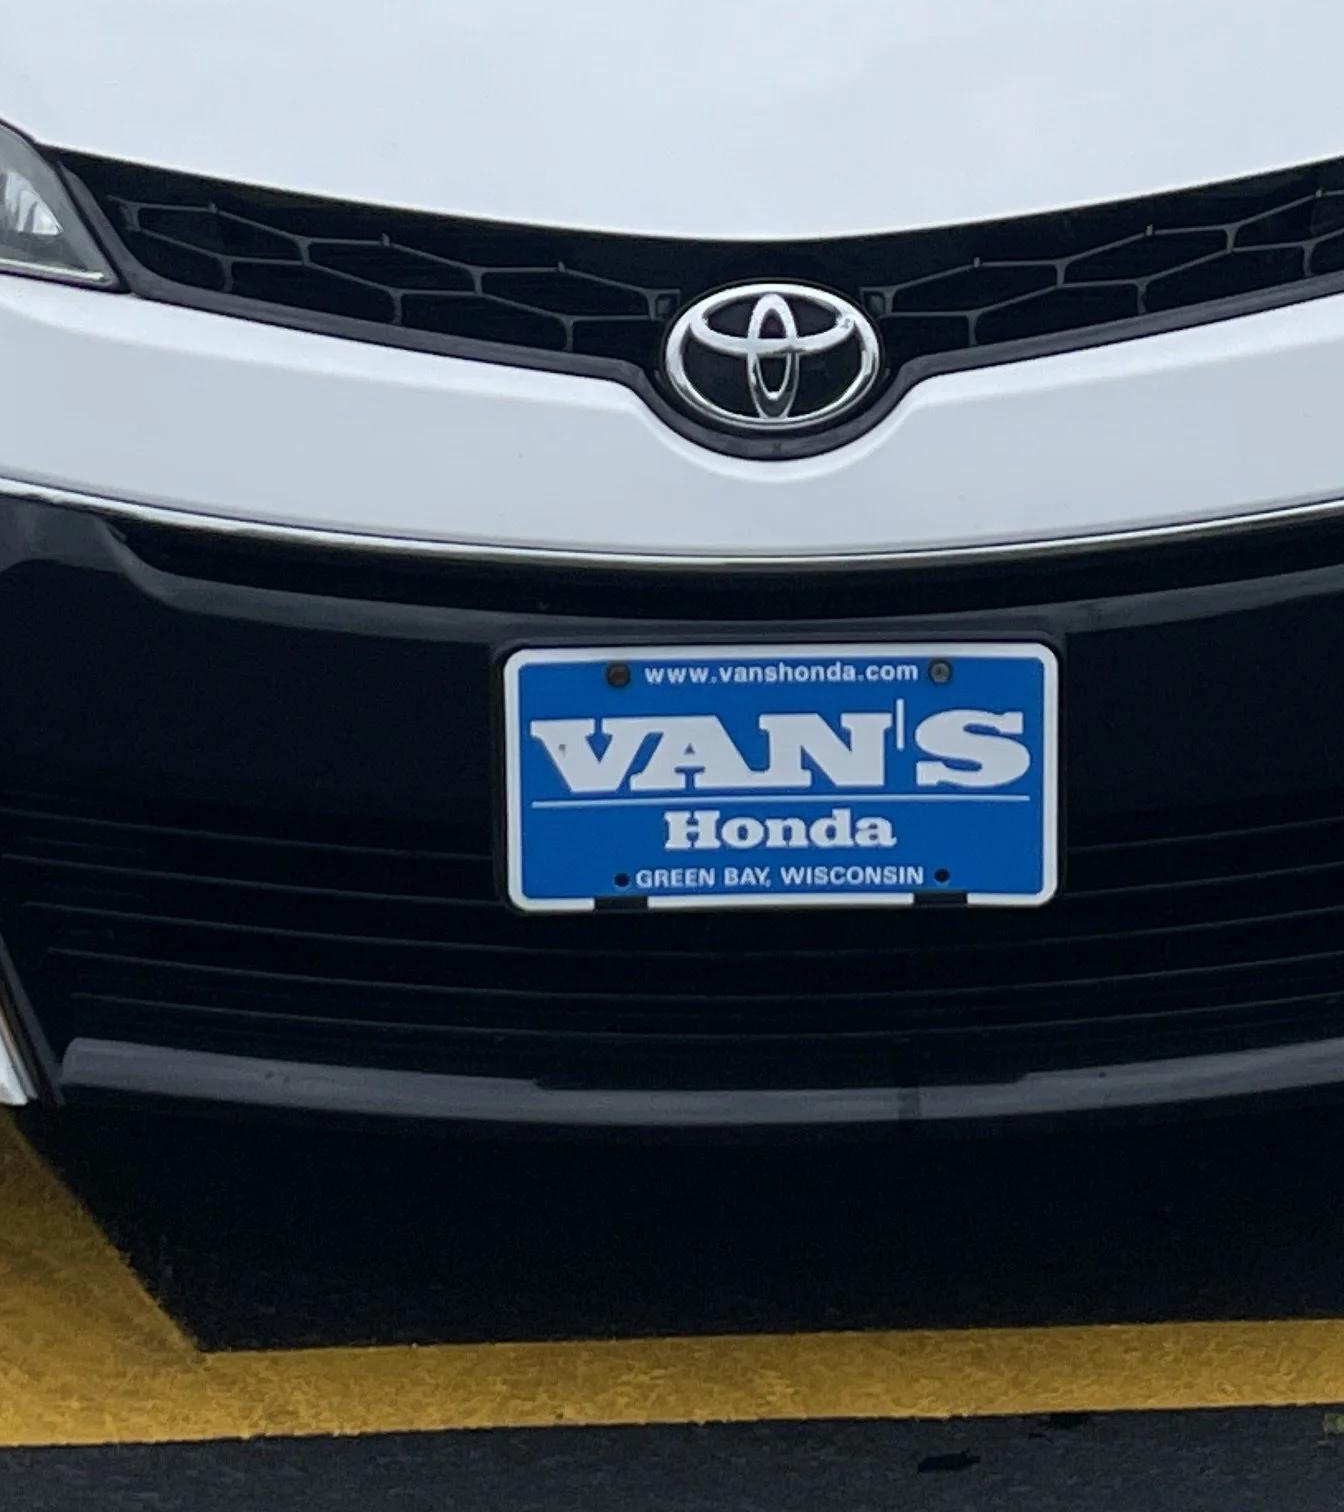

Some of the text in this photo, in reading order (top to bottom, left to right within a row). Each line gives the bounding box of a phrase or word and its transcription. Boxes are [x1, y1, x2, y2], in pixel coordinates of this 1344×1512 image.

[644, 661, 918, 684] www.vanshonda.com
[530, 698, 1031, 792] VAN'S
[664, 808, 897, 849] Honda
[635, 865, 924, 888] GREEN BAY, WISCONSIN
